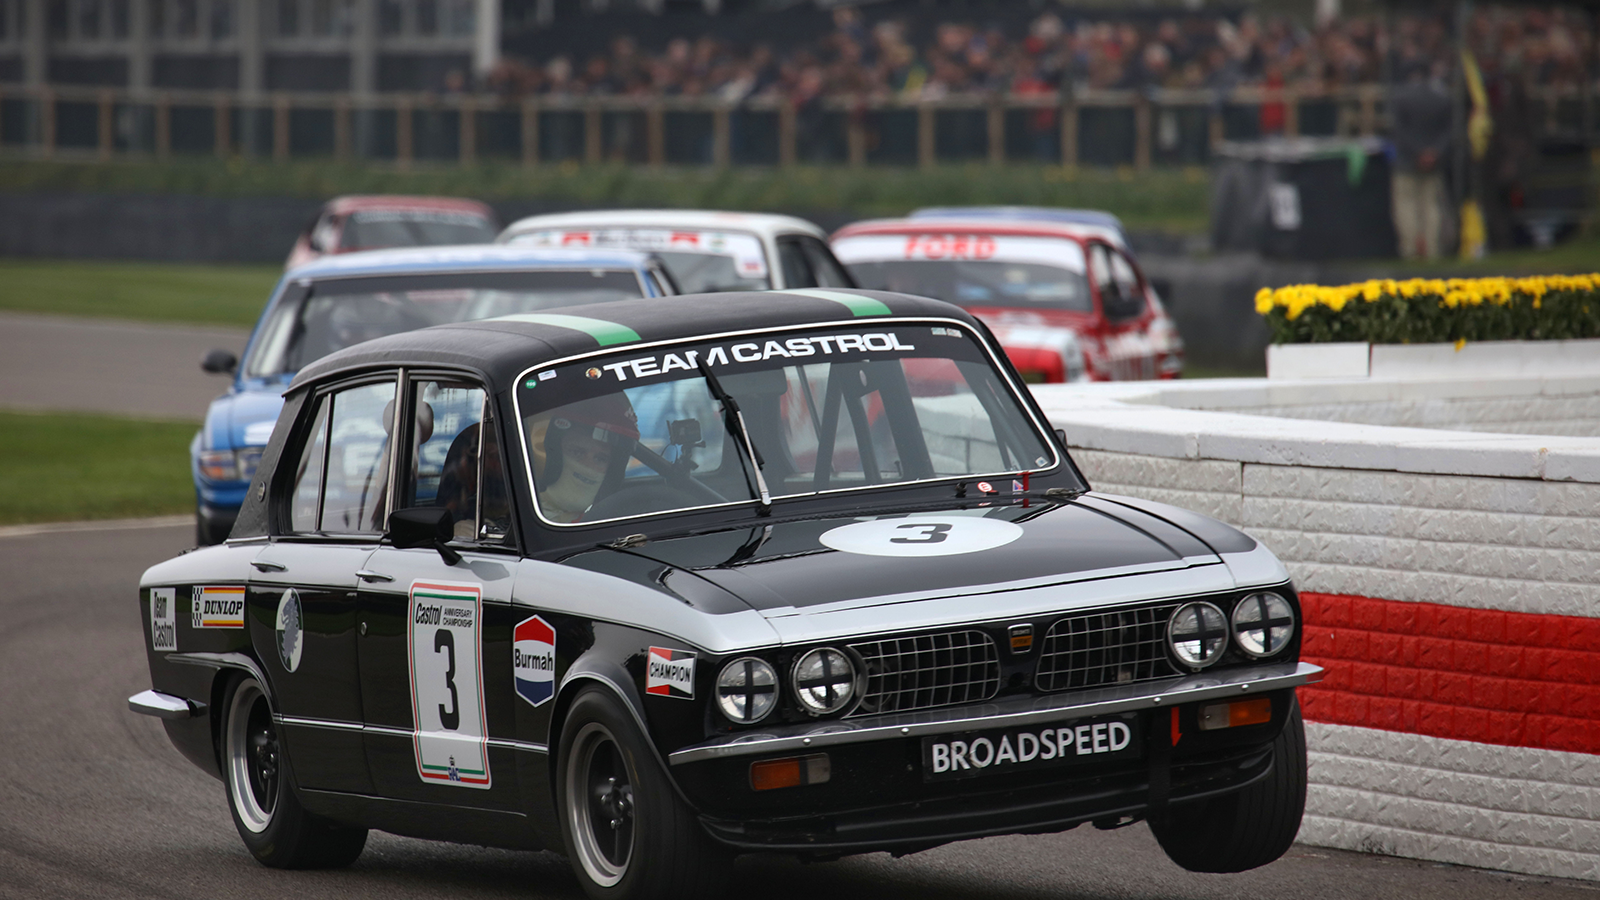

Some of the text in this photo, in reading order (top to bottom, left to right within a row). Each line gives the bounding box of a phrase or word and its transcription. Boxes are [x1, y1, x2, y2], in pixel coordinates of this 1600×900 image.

[904, 235, 996, 259] FORD
[603, 333, 915, 381] TEAM CASTROL
[890, 523, 953, 544] 3
[154, 591, 167, 619] Team
[194, 602, 199, 611] D
[203, 600, 243, 615] DUNLOP
[416, 603, 473, 625] Castrol ANNIVERSARY
[154, 620, 175, 648] Castrol
[443, 618, 473, 628] CHAMPIONSHIP
[514, 648, 553, 671] Burmah
[434, 628, 460, 730] 3
[650, 662, 691, 682] CHAMPION
[932, 721, 1132, 773] BROADSPEED
[448, 767, 461, 781] RAC
